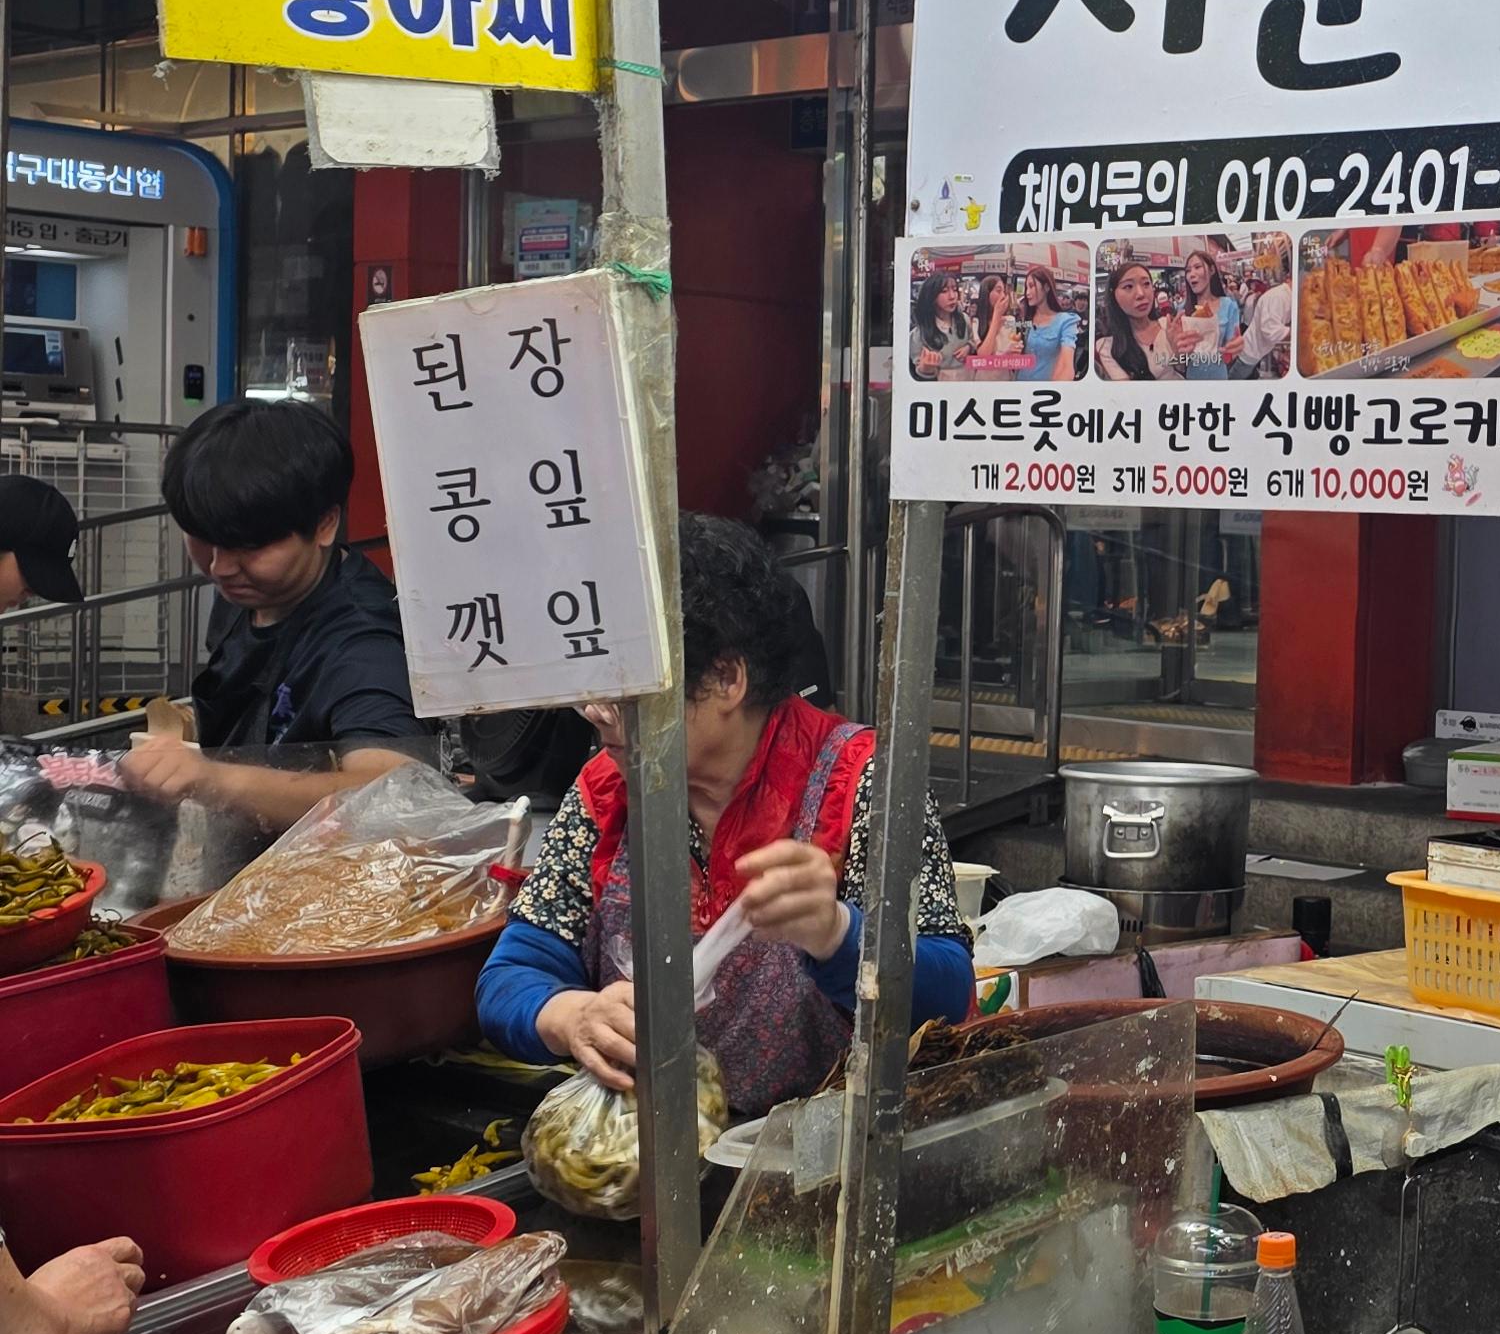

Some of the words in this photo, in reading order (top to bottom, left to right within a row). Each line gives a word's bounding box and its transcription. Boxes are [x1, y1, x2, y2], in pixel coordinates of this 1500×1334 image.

[1017, 158, 1189, 233] 체인문의
[909, 390, 1141, 451] 미스트롯에서
[1159, 402, 1235, 452] 반한
[971, 464, 999, 490] 1개
[1005, 462, 1095, 494] 2,000원
[1112, 466, 1145, 494] 3개
[1152, 465, 1248, 498] 5,000원
[1267, 469, 1304, 498] 6개
[1310, 467, 1429, 501] 10,000원
